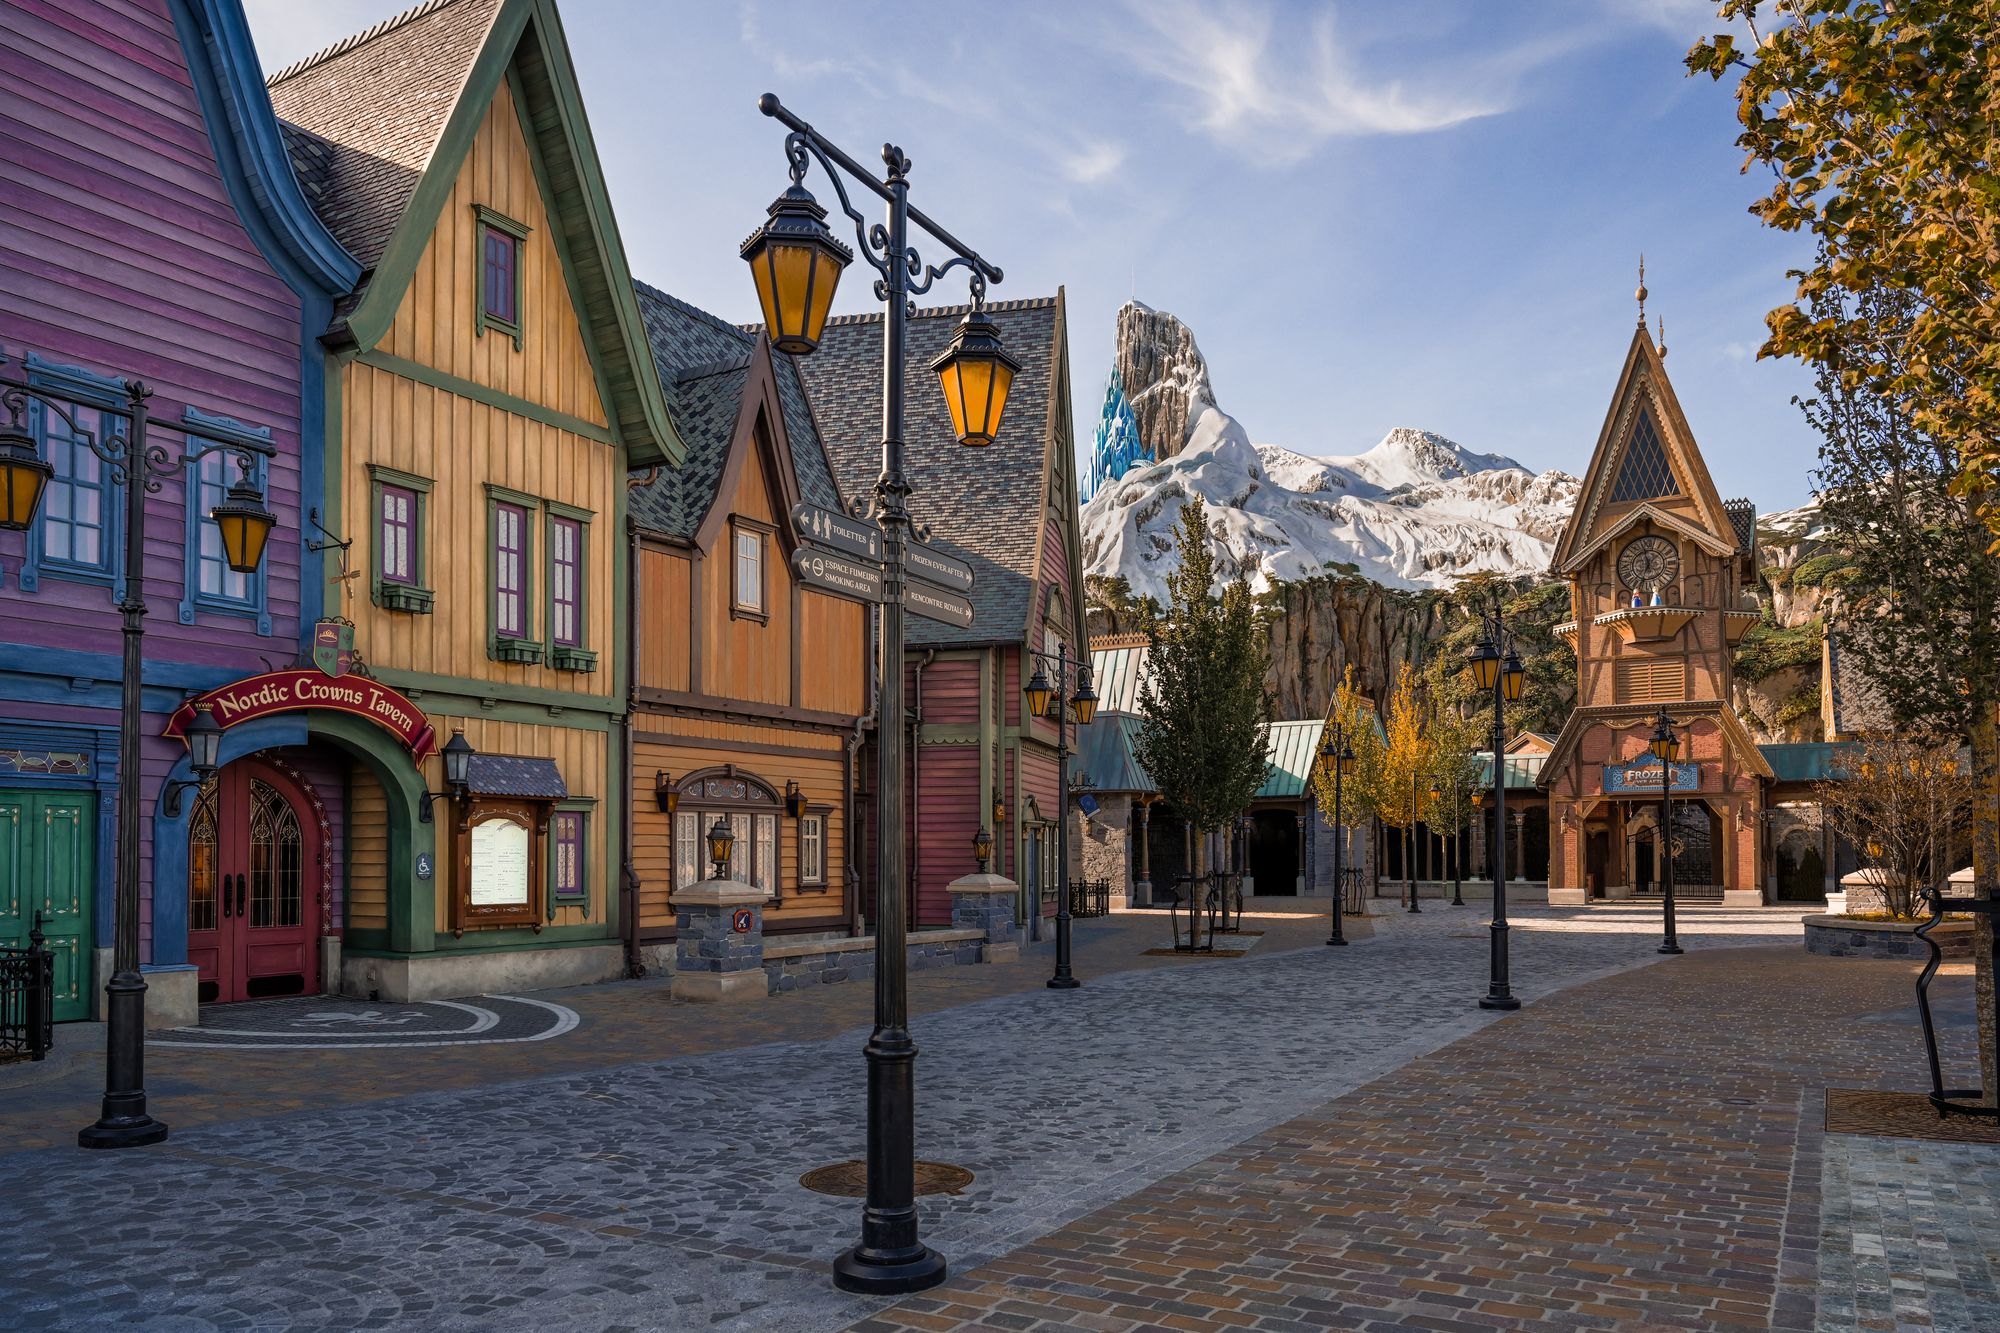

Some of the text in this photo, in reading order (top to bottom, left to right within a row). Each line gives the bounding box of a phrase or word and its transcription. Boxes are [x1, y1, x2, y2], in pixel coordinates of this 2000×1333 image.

[833, 525, 867, 543] TOILETTES
[825, 560, 880, 584] ESPACE FUMEURS
[911, 553, 964, 579] FROZEN EVER AFTER
[825, 572, 872, 593] SMOKING AREA
[911, 592, 964, 615] RENCONTRE ROYALE
[216, 678, 413, 732] Nordic Crowns Tavern
